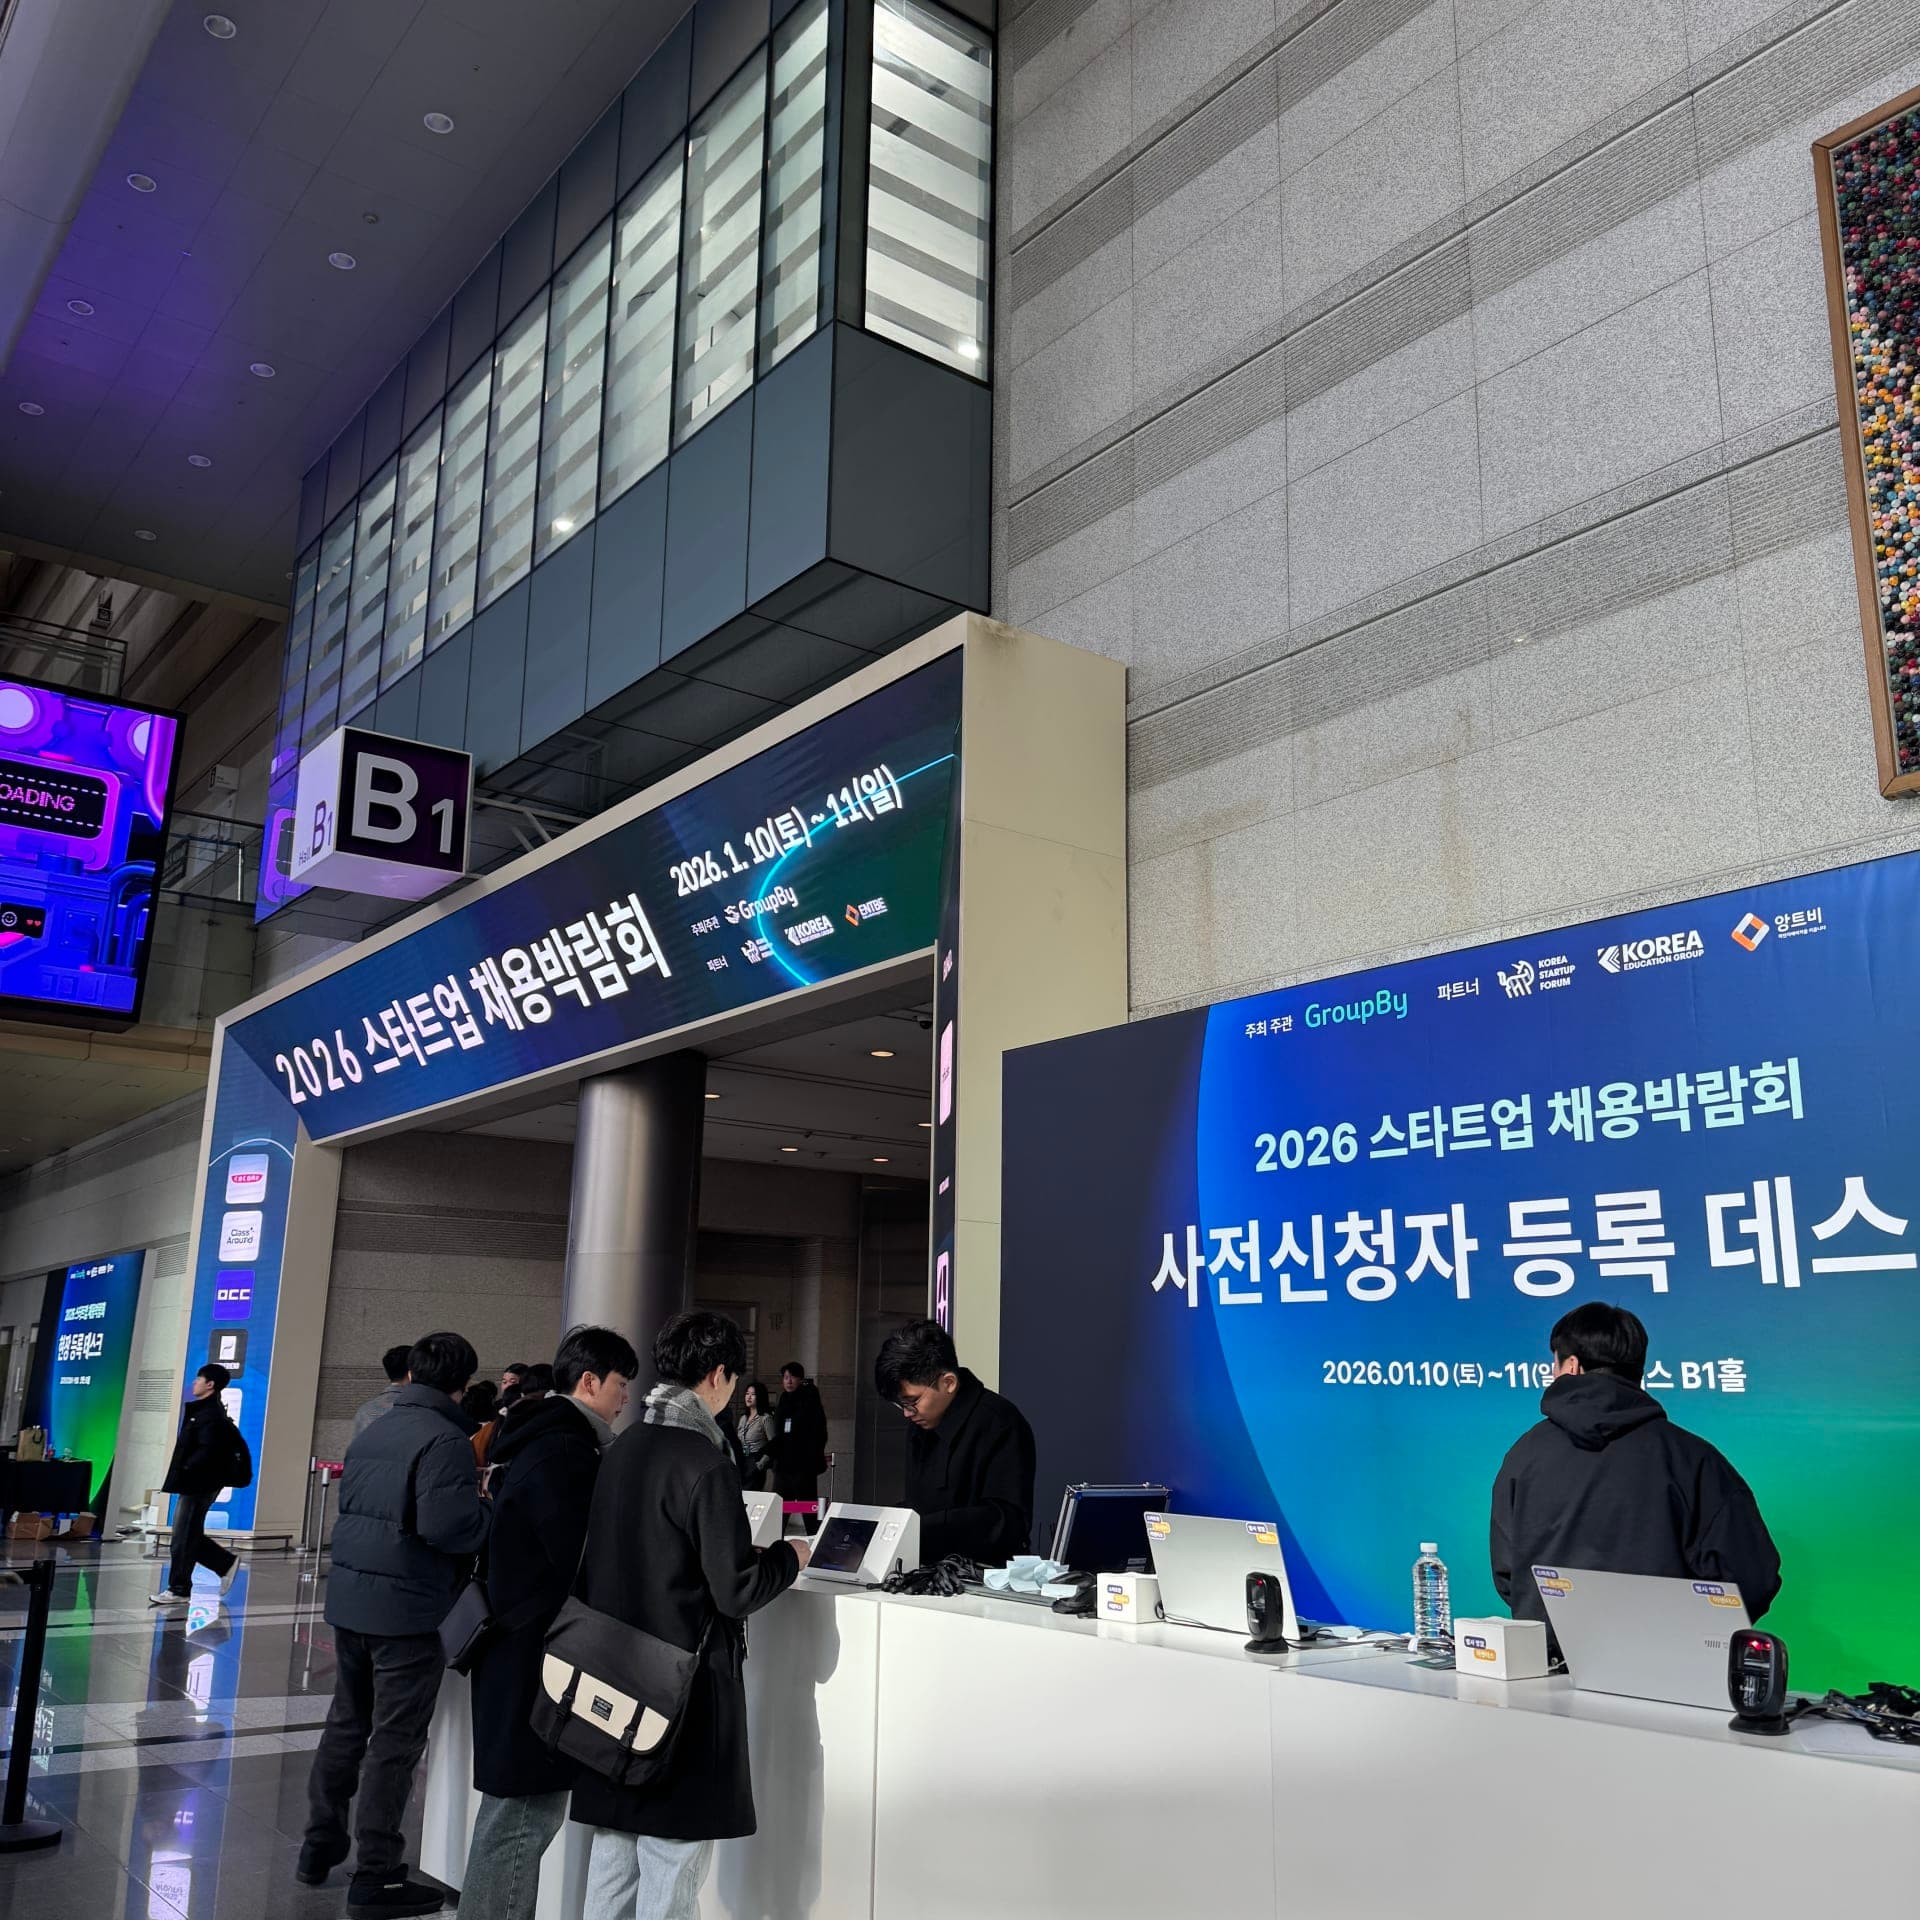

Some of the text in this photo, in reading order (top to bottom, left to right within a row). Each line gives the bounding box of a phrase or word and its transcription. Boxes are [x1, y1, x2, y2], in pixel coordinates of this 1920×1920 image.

[351, 751, 454, 854] B1
[312, 800, 333, 857] B1
[738, 886, 799, 920] GroupBy
[797, 915, 834, 939] KOREA
[1774, 907, 1822, 932] 앙트비
[1538, 955, 1568, 969] KOREA
[1622, 930, 1704, 962] KOREA
[1624, 949, 1705, 971] EDUCATION GROUP
[1539, 965, 1576, 980] STARTUP
[1539, 977, 1571, 991] FORUM
[275, 893, 672, 1105] 2026 스타트업 채용박람회
[1437, 978, 1480, 1001] 파트너
[1304, 990, 1408, 1028] GroupBy
[1245, 1015, 1293, 1039] 주최 주관
[1254, 1057, 1804, 1173] 2026 스타트업 채용박람회
[1151, 1176, 1918, 1308] 사전신청자 등록 데스
[1681, 1357, 1747, 1393] B1홀
